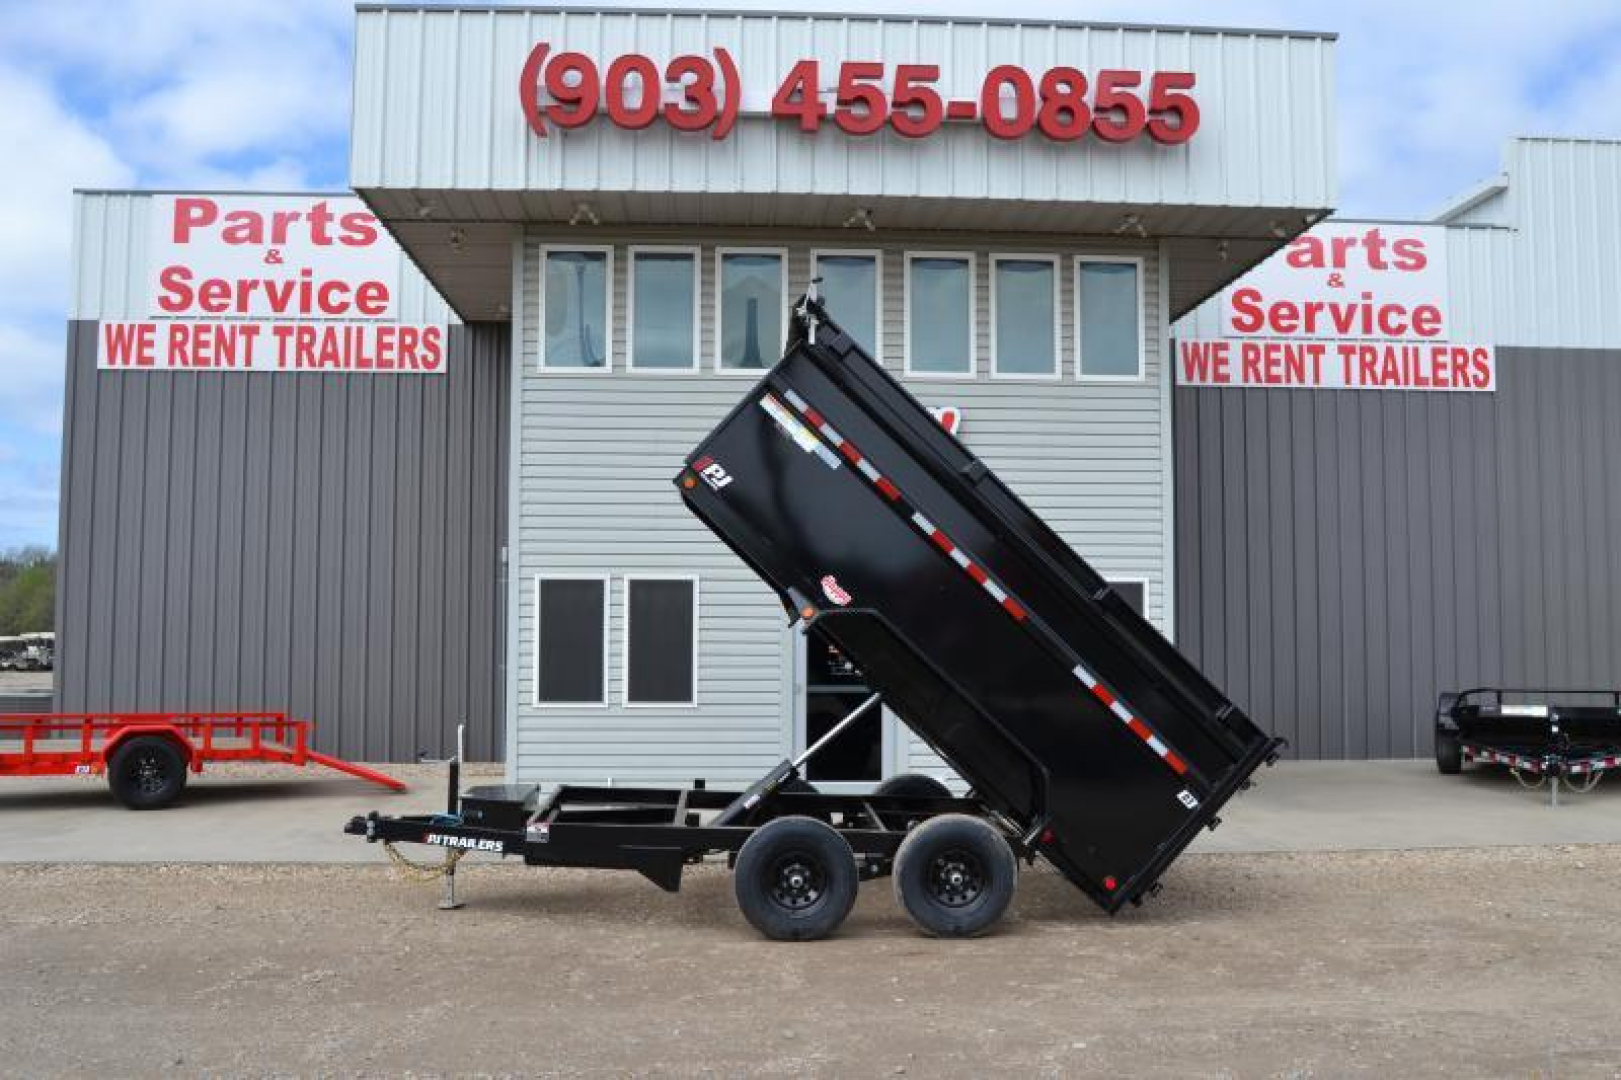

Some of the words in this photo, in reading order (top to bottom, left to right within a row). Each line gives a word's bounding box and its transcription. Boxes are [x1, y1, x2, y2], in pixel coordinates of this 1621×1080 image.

[519, 43, 742, 139] (903)
[772, 59, 1200, 144] 455-0855
[172, 199, 378, 246] Parts
[264, 249, 284, 265] &
[1286, 227, 1427, 272] arts
[158, 266, 390, 315] Service
[1327, 273, 1345, 288] &
[1231, 287, 1443, 337] Service
[105, 324, 156, 367] WE
[168, 324, 260, 369] RENT
[272, 325, 442, 371] TRAILERS
[1182, 342, 1231, 384] WE
[1242, 342, 1326, 386] RENT
[1337, 344, 1491, 389] TRAILERS
